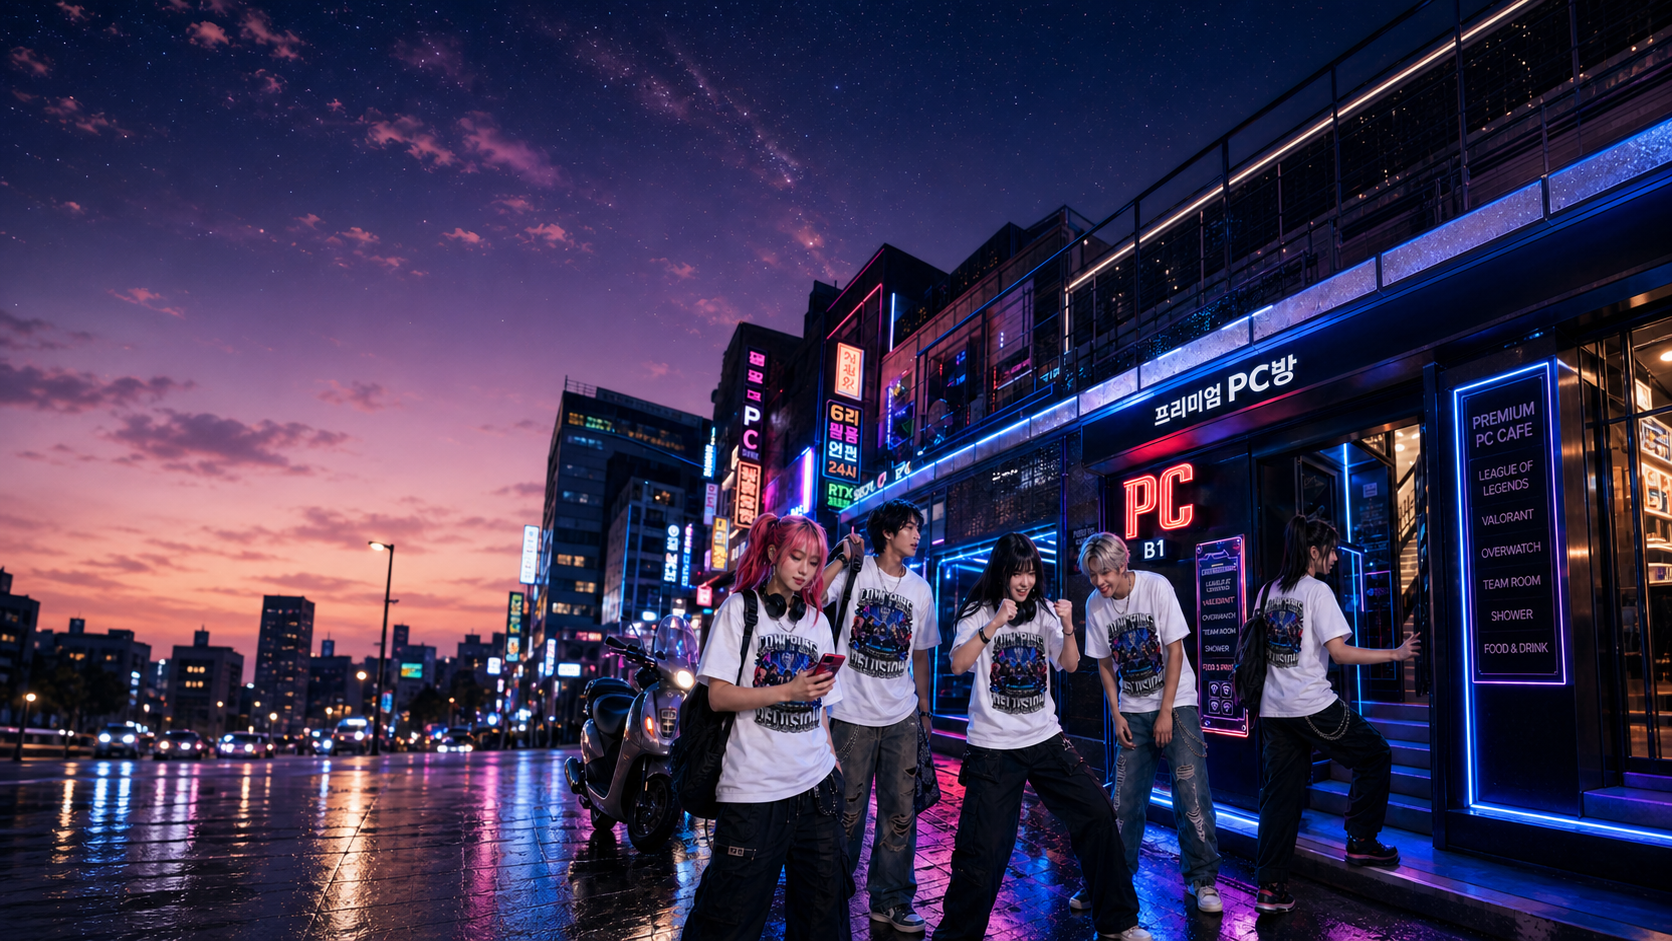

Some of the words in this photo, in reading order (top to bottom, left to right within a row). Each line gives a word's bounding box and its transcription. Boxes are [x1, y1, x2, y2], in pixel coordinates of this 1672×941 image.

[1154, 382, 1221, 426] 프리미엄
[1228, 353, 1298, 403] PC방
[1472, 401, 1535, 430] PREMIUM
[1476, 431, 1494, 448] PC
[1497, 422, 1533, 443] CAFE
[828, 460, 857, 478] 24시
[1478, 463, 1517, 481] LEAGUE
[1519, 460, 1534, 473] OF
[828, 483, 854, 499] RTX
[1483, 478, 1529, 496] LEGENDS
[1123, 463, 1194, 540] PC
[1482, 508, 1534, 526] VALORANT
[1144, 539, 1164, 559] B1
[1481, 541, 1541, 558] OVERWATCH
[1483, 577, 1509, 590] TEAM
[1511, 575, 1541, 588] ROOM
[1491, 609, 1534, 622] SHOWER
[1484, 643, 1509, 654] FOOD
[1510, 643, 1518, 654] &
[1519, 642, 1549, 654] DRINK
